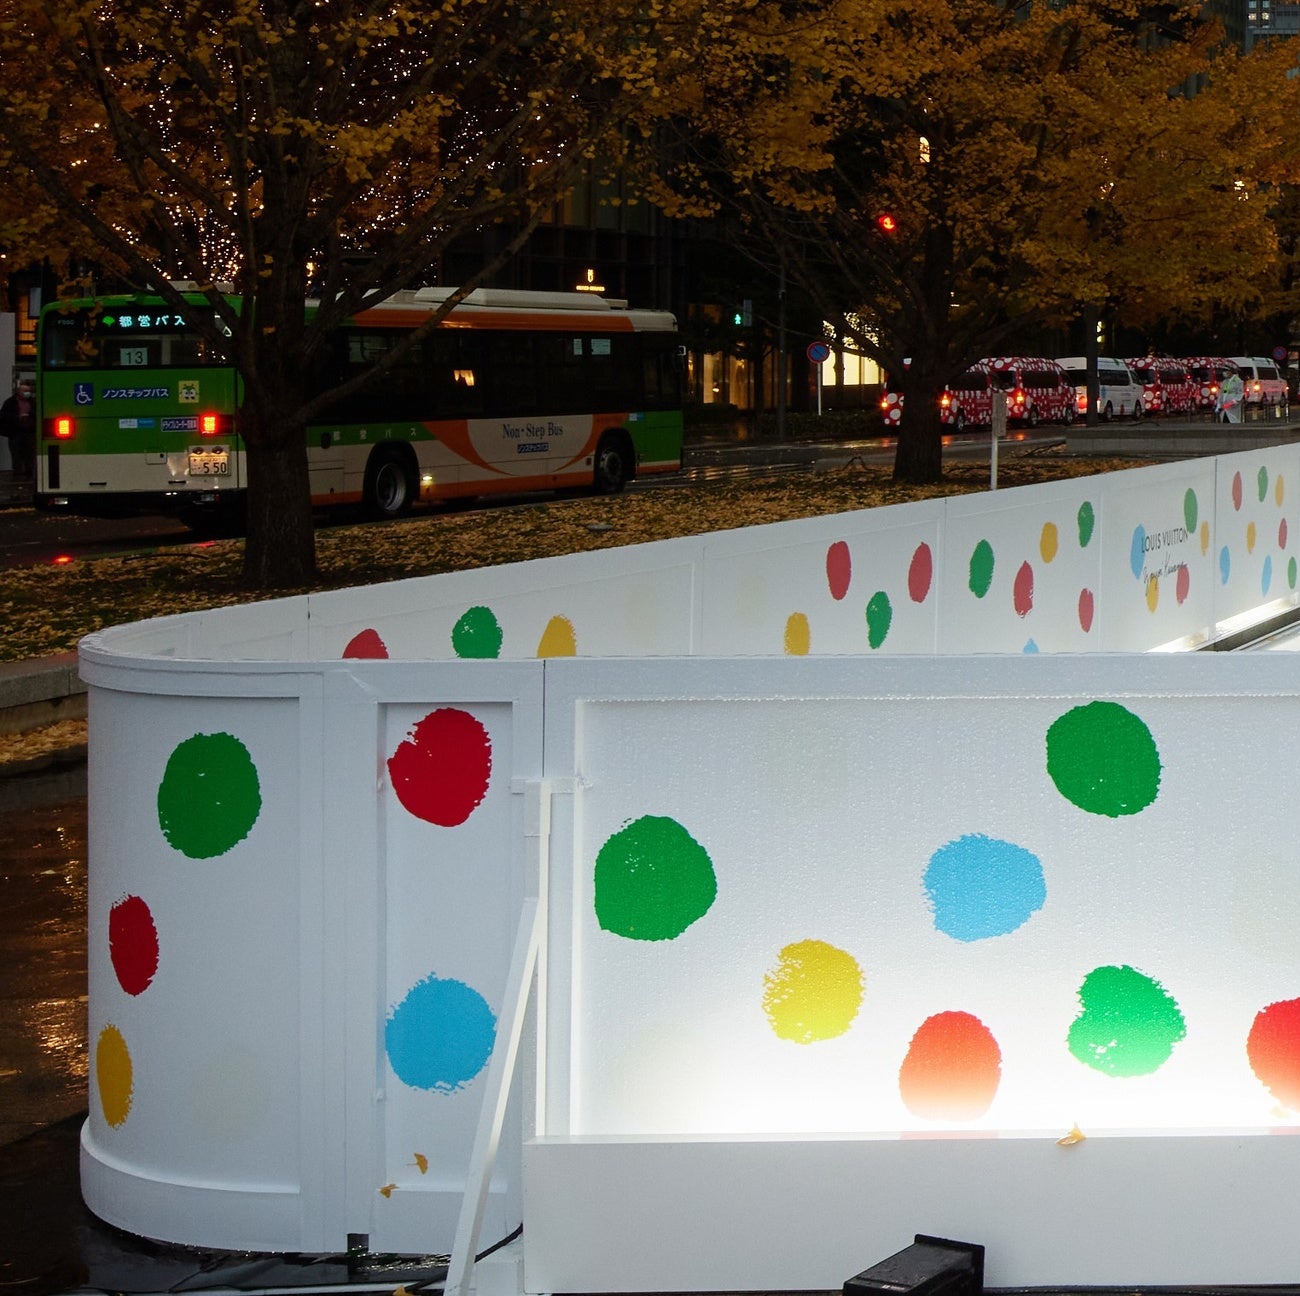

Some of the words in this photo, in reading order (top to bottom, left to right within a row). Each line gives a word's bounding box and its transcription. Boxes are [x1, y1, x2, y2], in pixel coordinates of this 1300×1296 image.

[118, 315, 186, 328] 都営バス
[126, 351, 144, 365] 13
[103, 388, 169, 398] ノンステップバス
[548, 422, 564, 436] Bus
[1141, 532, 1161, 554] LOUIS
[1162, 527, 1189, 546] VUITTON
